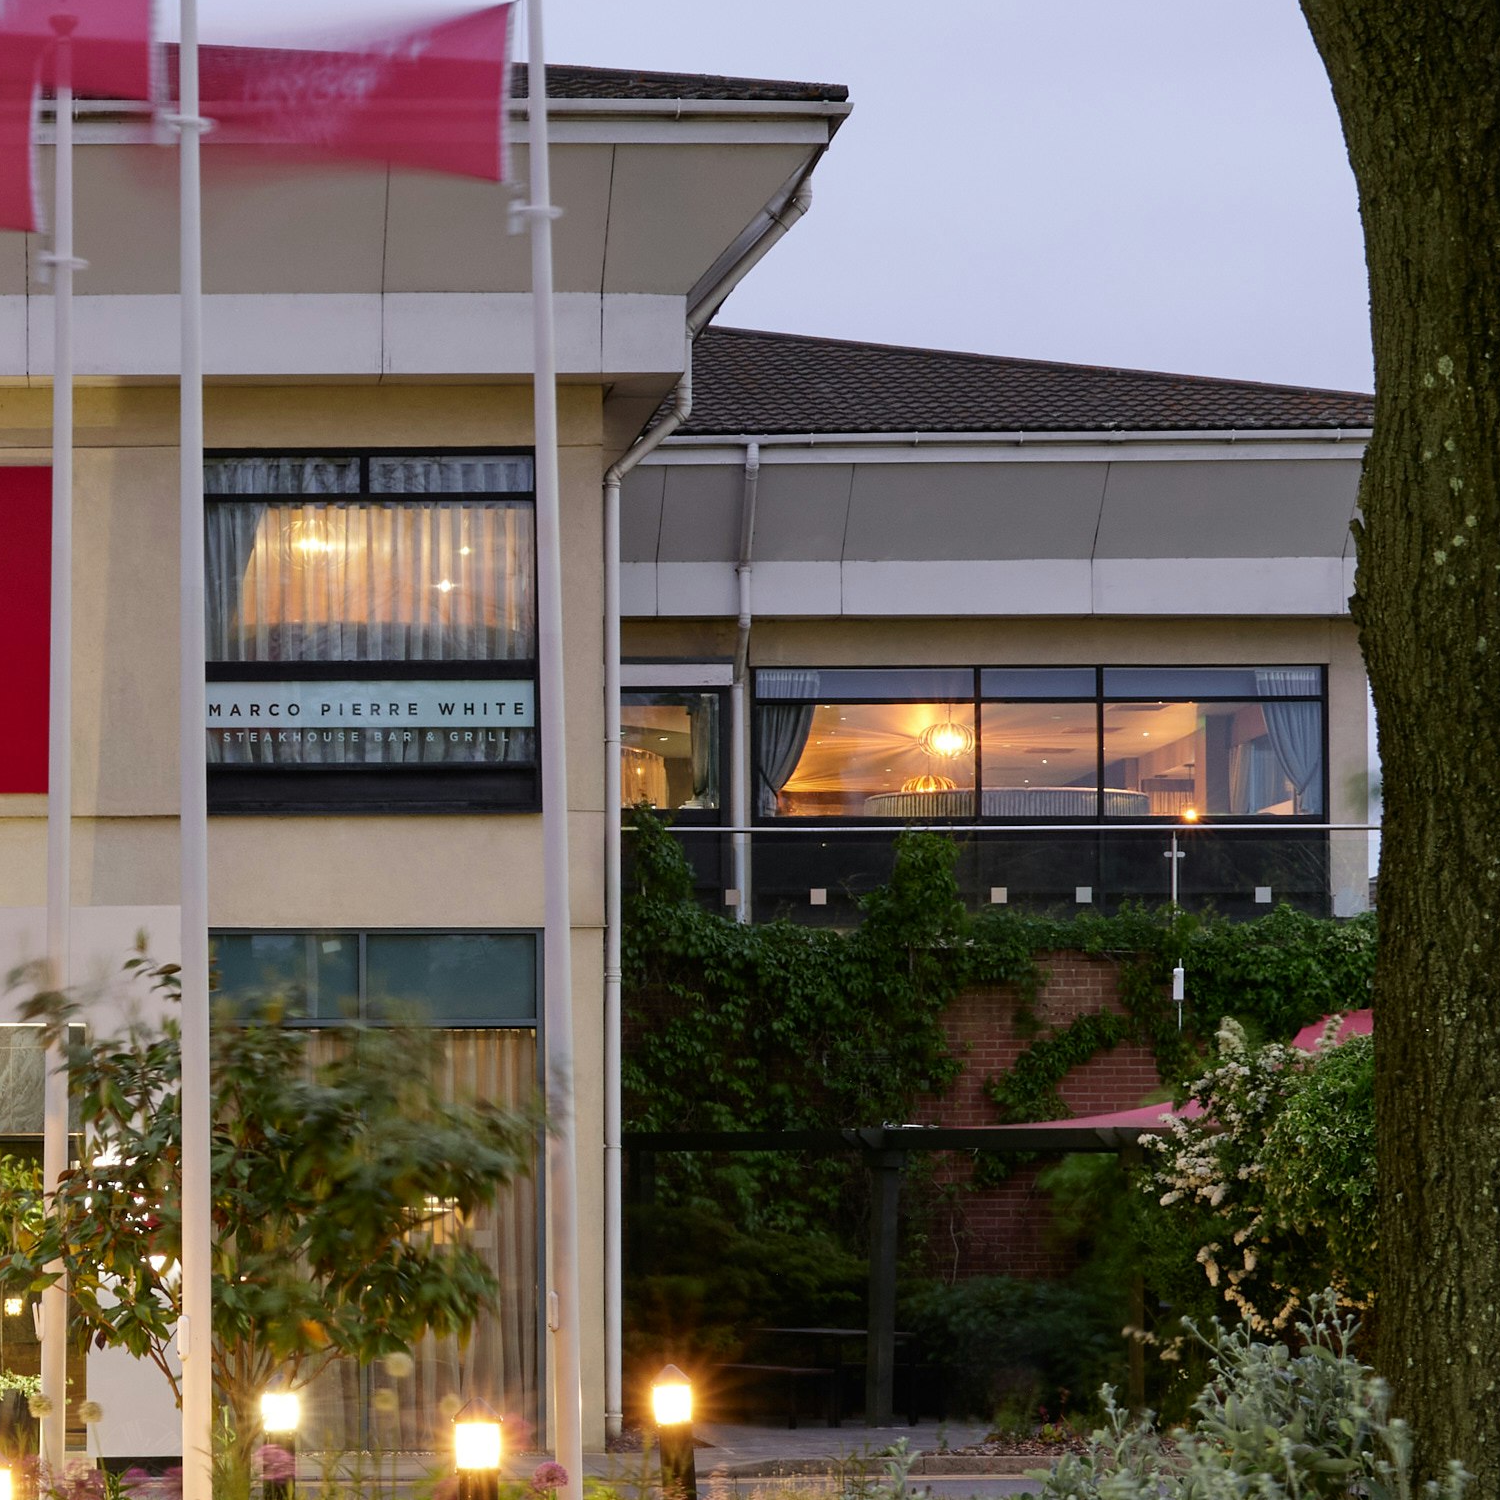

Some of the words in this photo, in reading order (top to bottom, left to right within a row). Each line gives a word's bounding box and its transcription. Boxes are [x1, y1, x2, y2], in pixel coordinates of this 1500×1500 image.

[208, 704, 301, 717] MARCO
[321, 703, 419, 716] PIERRE
[438, 703, 525, 716] WHITE
[223, 732, 359, 743] STEAKHOUSE
[374, 732, 412, 743] BAR
[426, 732, 435, 743] &
[449, 732, 509, 742] GRILL
